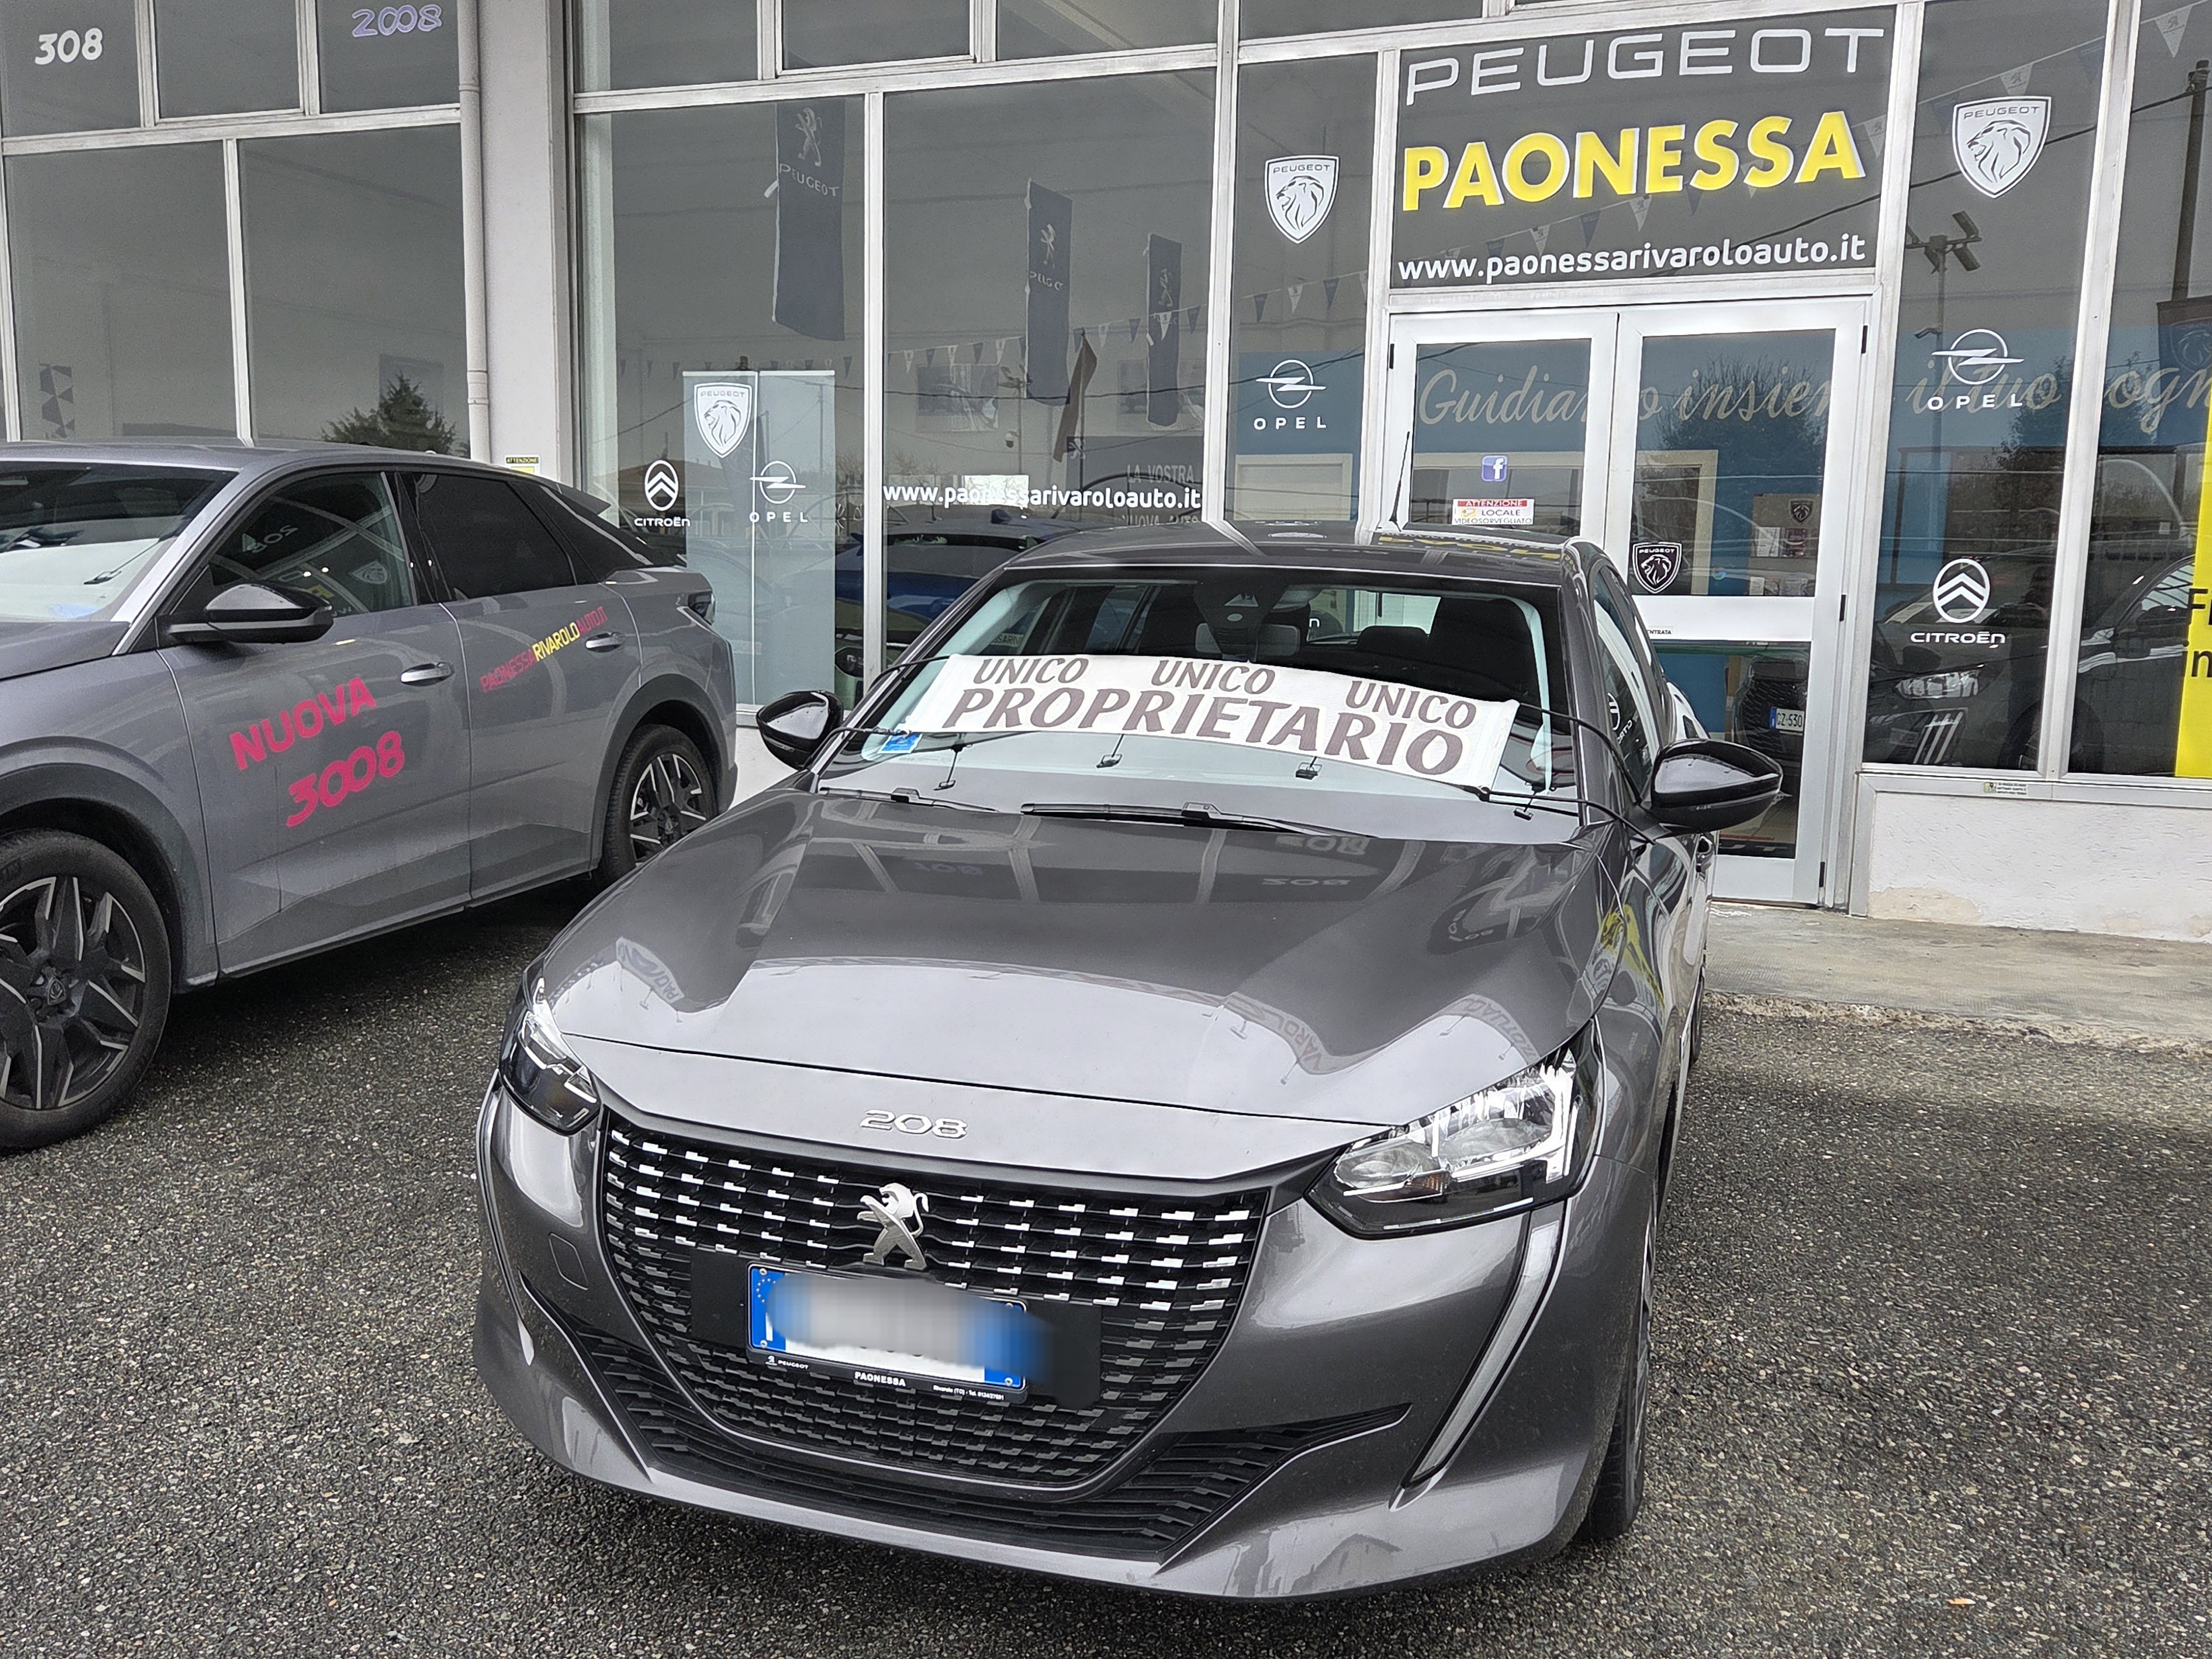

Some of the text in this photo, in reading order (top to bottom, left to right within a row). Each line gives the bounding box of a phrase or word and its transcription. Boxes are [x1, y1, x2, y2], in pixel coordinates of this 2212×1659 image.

[352, 4, 443, 38] 2008
[34, 28, 103, 65] 308
[1405, 28, 1885, 106] PEUGEOT
[1963, 106, 2041, 119] PEUGEOT
[1273, 163, 1332, 175] PEUGEOT
[1402, 111, 1866, 212] PAONESSA
[1398, 233, 1866, 284] www.paonessarivaroloauto.it
[1927, 394, 2023, 411] OPEL
[1254, 415, 1327, 430] OPEL
[1147, 465, 1194, 483] VOSTRA
[883, 487, 1201, 509] www.paonessarivaroloauto.it
[749, 512, 808, 523] OPEL
[973, 657, 1477, 730] UNICO UNICO UNICO
[229, 677, 377, 771] NUOVA
[942, 686, 1465, 776] PROPRIETARIO
[286, 731, 405, 828] 3008
[860, 1110, 968, 1139] 208
[778, 1360, 808, 1369] PEUGEOT
[854, 1371, 906, 1387] PAONESSA
